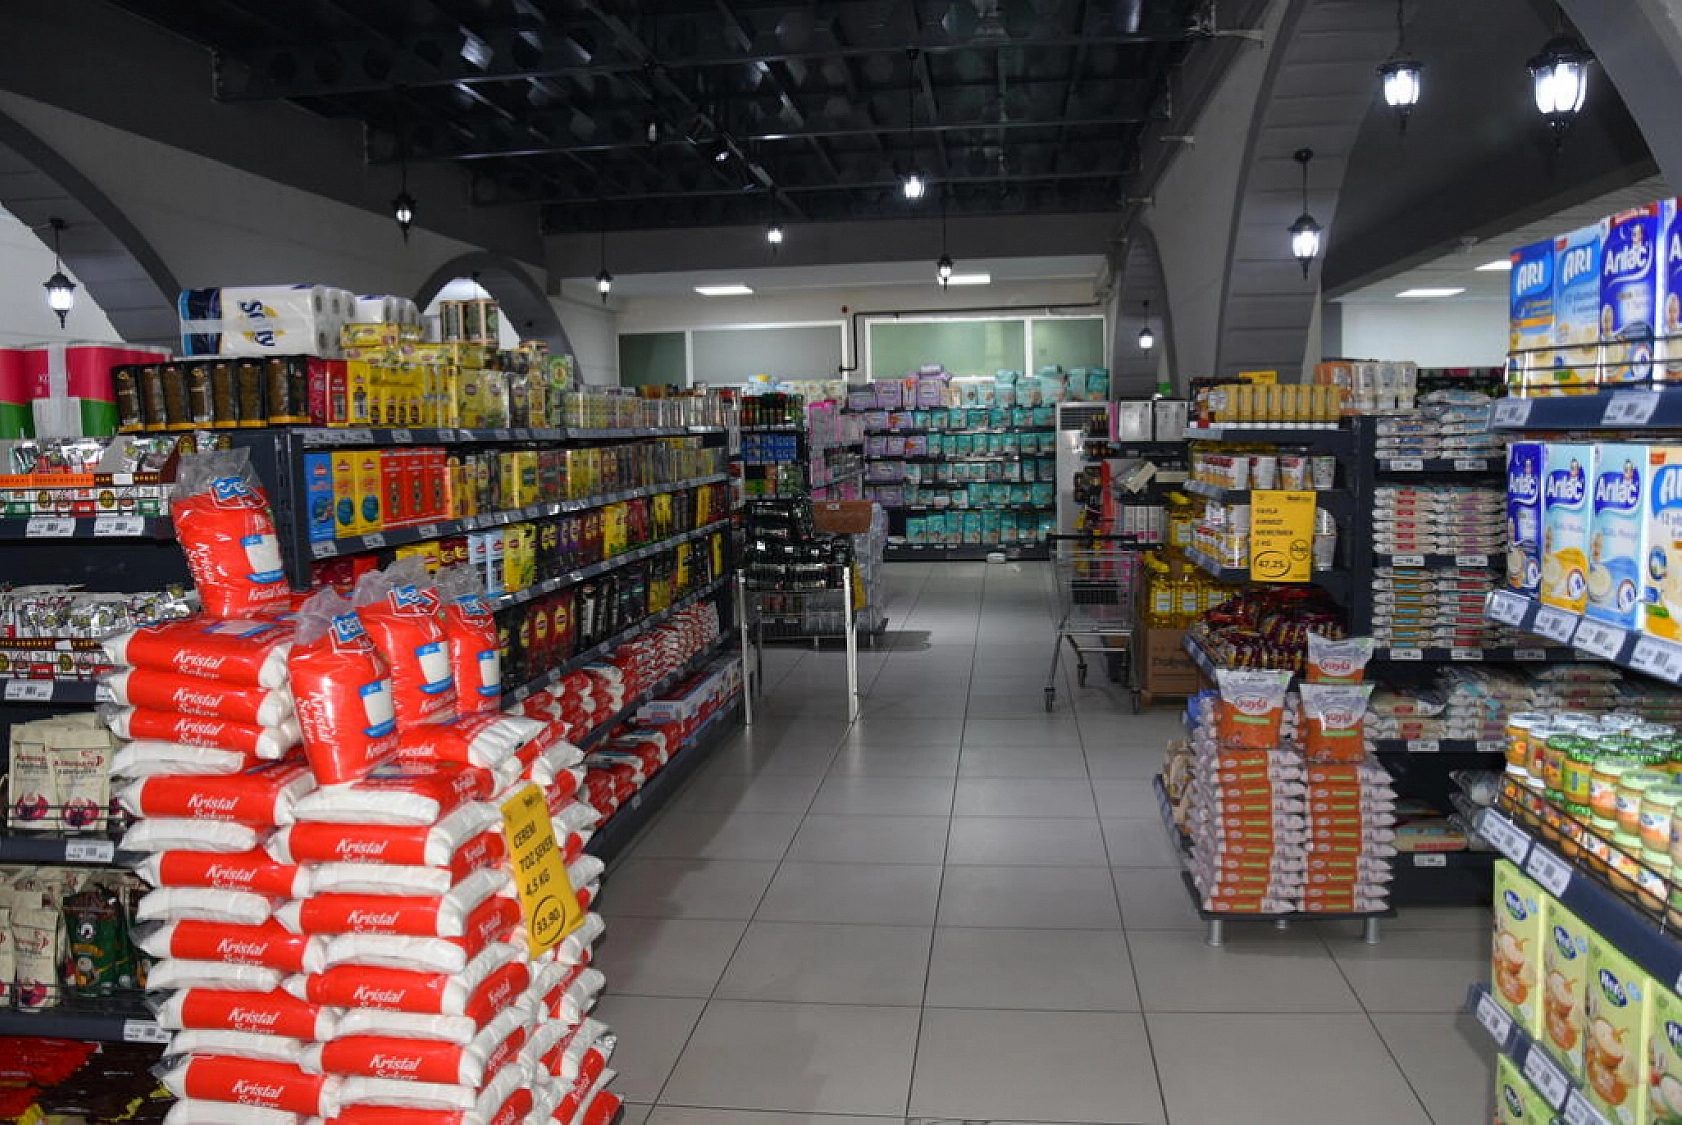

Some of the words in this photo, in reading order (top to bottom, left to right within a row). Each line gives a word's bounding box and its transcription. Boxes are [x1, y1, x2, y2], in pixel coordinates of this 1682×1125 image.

[1563, 246, 1591, 285] ARI
[1517, 261, 1544, 295] ARI
[172, 649, 224, 671] Kristal
[172, 686, 223, 708] Kristal
[173, 717, 226, 736] Kristal
[396, 743, 436, 758] ristal
[187, 792, 240, 810] Kristal
[513, 821, 537, 848] CEREM
[335, 838, 388, 855] Kristal
[205, 863, 259, 882] Kristal
[538, 867, 551, 887] KG
[346, 909, 400, 926] Kristal
[216, 937, 270, 957] Kristal
[352, 985, 406, 1003] Kristal
[228, 1007, 281, 1026] Kristal
[368, 1053, 423, 1071] Kristal
[232, 1080, 285, 1098] Kristal
